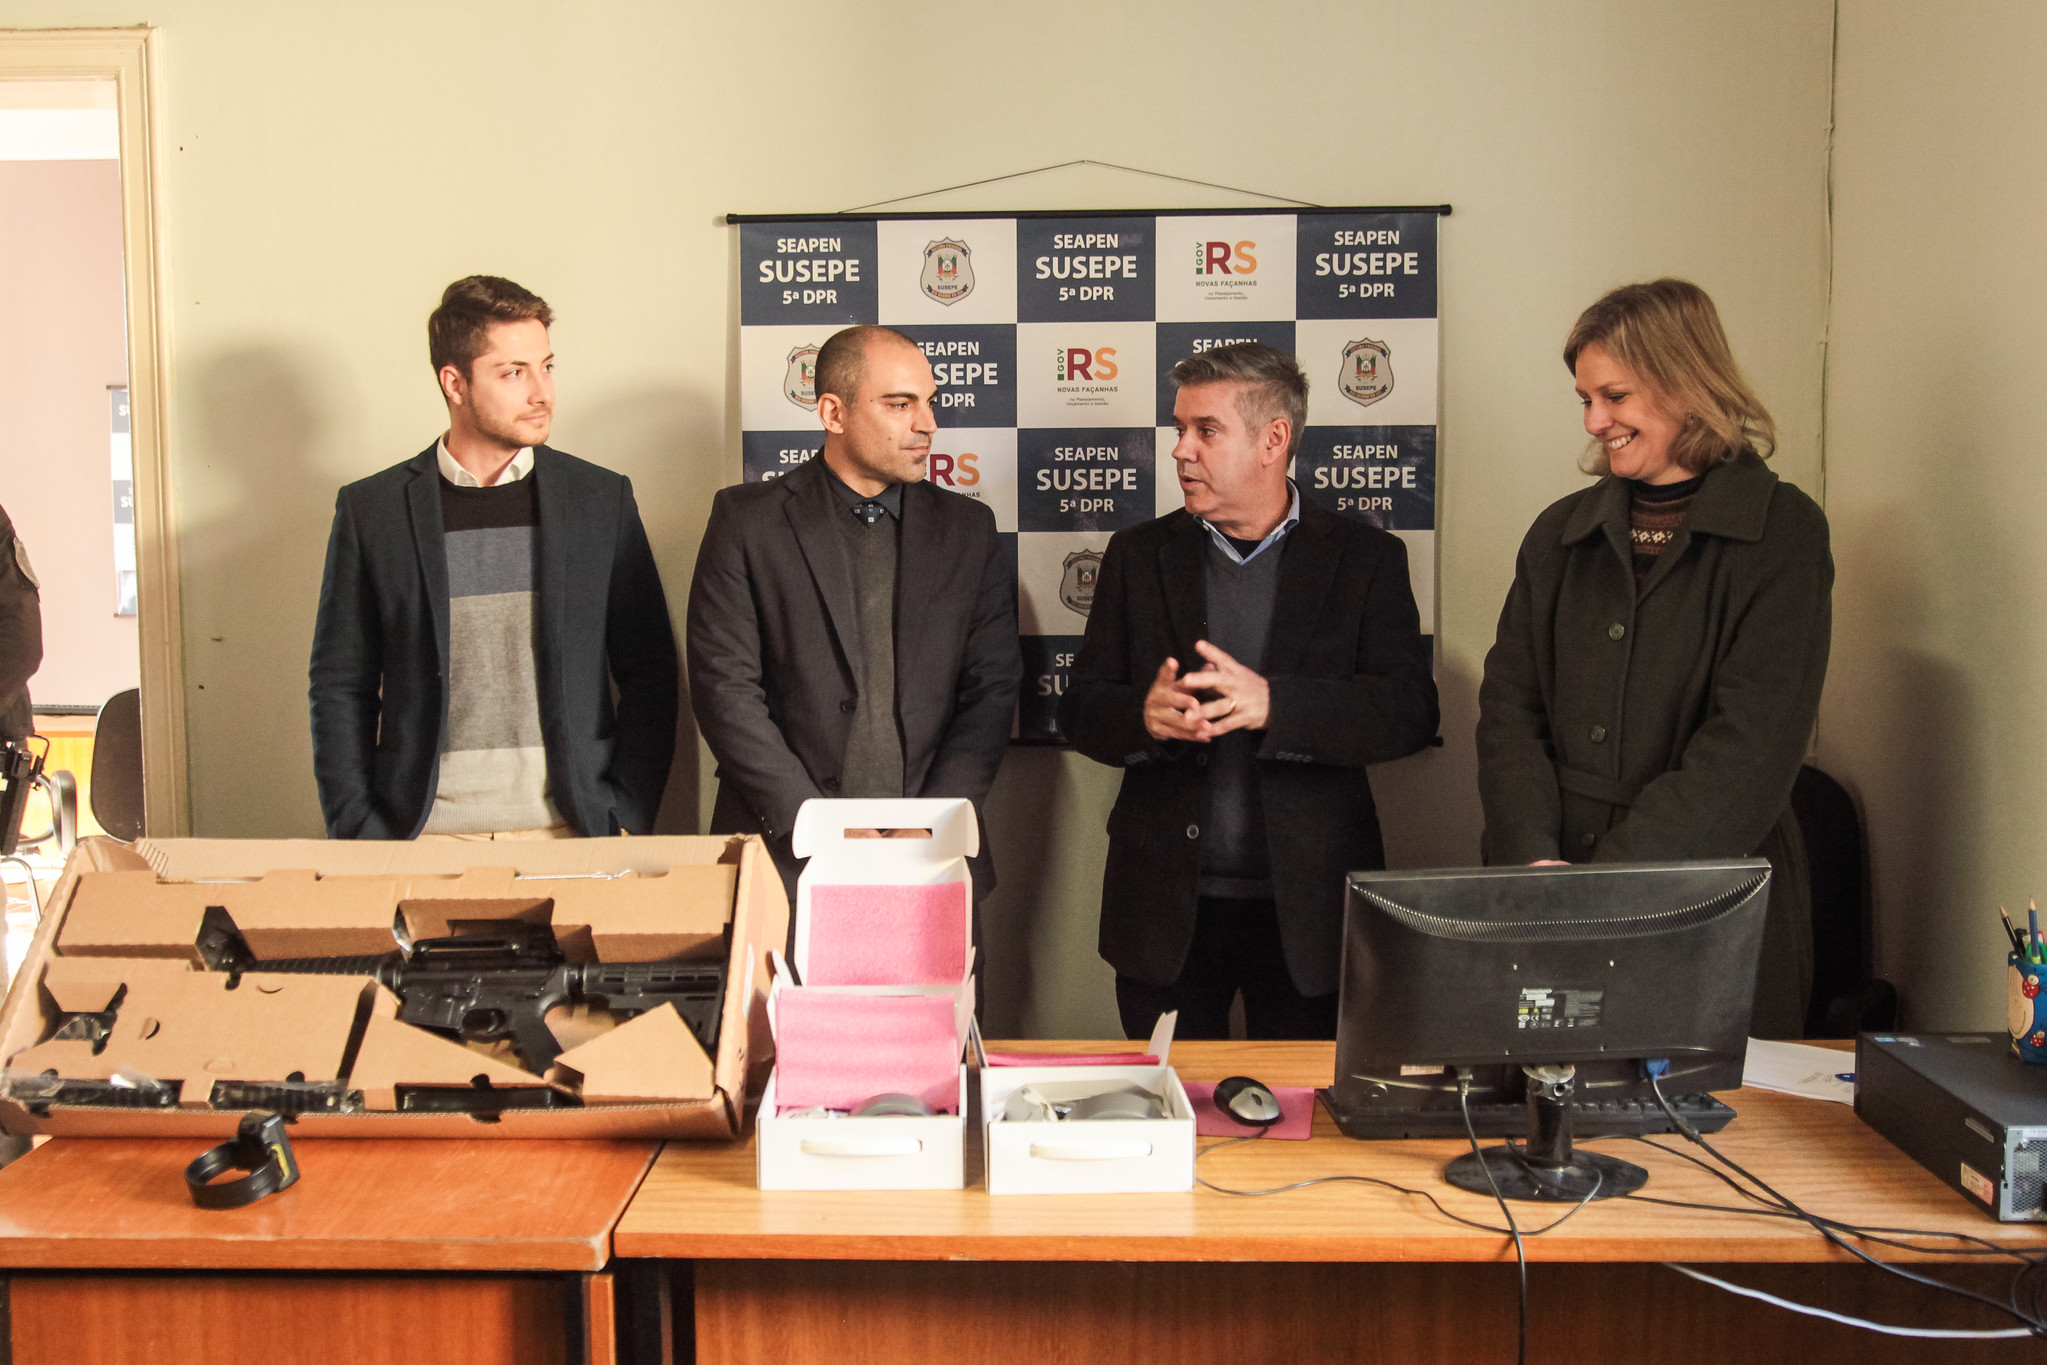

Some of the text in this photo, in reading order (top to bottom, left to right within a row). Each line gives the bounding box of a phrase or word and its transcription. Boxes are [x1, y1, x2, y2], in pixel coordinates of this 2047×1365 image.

[777, 238, 841, 254] SEAPEN
[1054, 234, 1119, 250] SEAPEN
[1335, 231, 1400, 246] SEAPEN
[1195, 242, 1204, 266] GOV
[1206, 240, 1258, 275] RS
[760, 260, 860, 283] SUSEPE
[1036, 256, 1138, 280] SUSEPE
[1316, 253, 1419, 276] SUSEPE
[1220, 280, 1258, 288] FAÇANHAS
[1361, 283, 1395, 298] DPR
[804, 290, 838, 305] DPR
[1080, 286, 1114, 301] DPR
[1057, 348, 1065, 372] GOV
[1067, 347, 1119, 382] RS
[930, 362, 999, 386] SEPE
[1081, 386, 1119, 394] FAÇANHAS
[942, 393, 976, 408] DPR
[1055, 447, 1119, 462] SEAPEN
[1333, 445, 1398, 460] SEAPEN
[929, 452, 981, 487] RS
[1315, 466, 1417, 489] SUSEPE
[1037, 469, 1137, 491] SUSEPE
[1081, 499, 1114, 513] DPR
[1359, 497, 1393, 511] DPR
